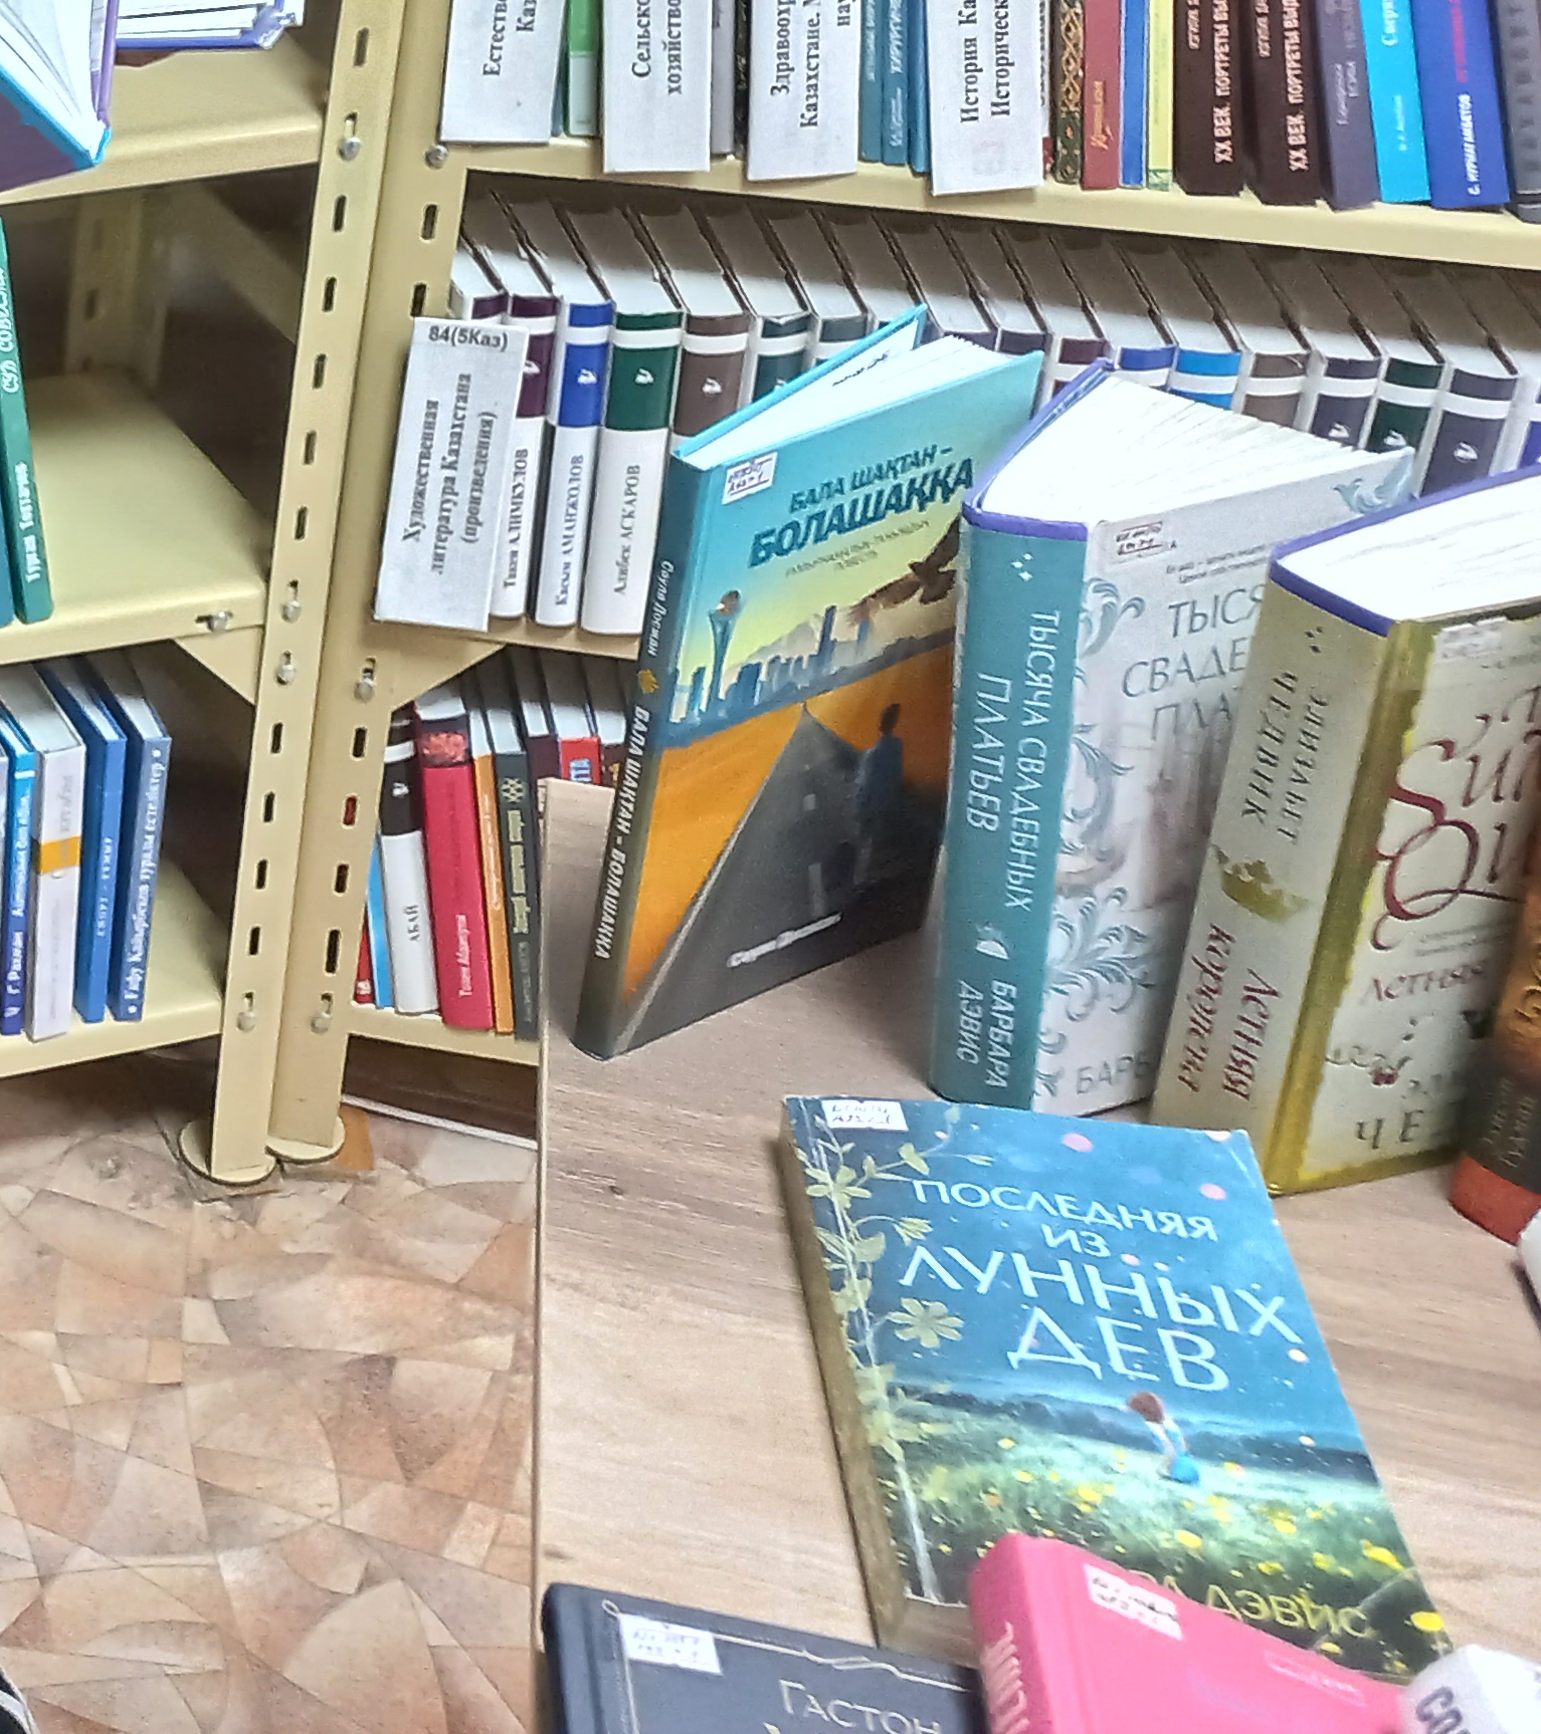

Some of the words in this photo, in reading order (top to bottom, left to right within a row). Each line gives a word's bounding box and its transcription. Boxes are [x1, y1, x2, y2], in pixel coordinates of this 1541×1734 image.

[797, 12, 821, 128] Казахстане.
[957, 38, 981, 122] История
[1213, 24, 1230, 95] ПОРТРЕТЫ
[1283, 30, 1303, 103] ПОРТРЕТЫ
[428, 325, 509, 350] 84(5Каз)
[438, 371, 473, 472] Казахстана
[401, 398, 446, 544] Художественная
[456, 410, 501, 544] (произведения)
[559, 453, 584, 555] АМАНЖОЛОВ
[618, 463, 641, 539] АСКАРОВ
[748, 454, 974, 568] БОЛАШАҚҚА
[783, 474, 850, 516] БАЛА
[844, 437, 944, 496] ШАҚТАН
[426, 474, 461, 575] литература
[612, 543, 632, 594] Алибек
[1021, 609, 1061, 730] ТЫСЯЧА
[624, 703, 651, 761] БАЛА
[960, 672, 1013, 824] ПЛАТЬЕВ
[1240, 668, 1300, 825] ЧЕДВИК
[1001, 735, 1047, 914] СВАДЕБНЫХ
[403, 904, 421, 941] АБАЙ
[951, 981, 986, 1066] ДЭВИС
[982, 980, 1018, 1088] БАРБАРА
[913, 1176, 1219, 1242] ПОСЛЕДНЯЯ
[1043, 1226, 1111, 1260] ИЗ
[899, 1246, 1305, 1342] ЛУННЫХ
[1007, 1310, 1229, 1392] ДЕВ
[1207, 1584, 1369, 1642] ДЭВИС
